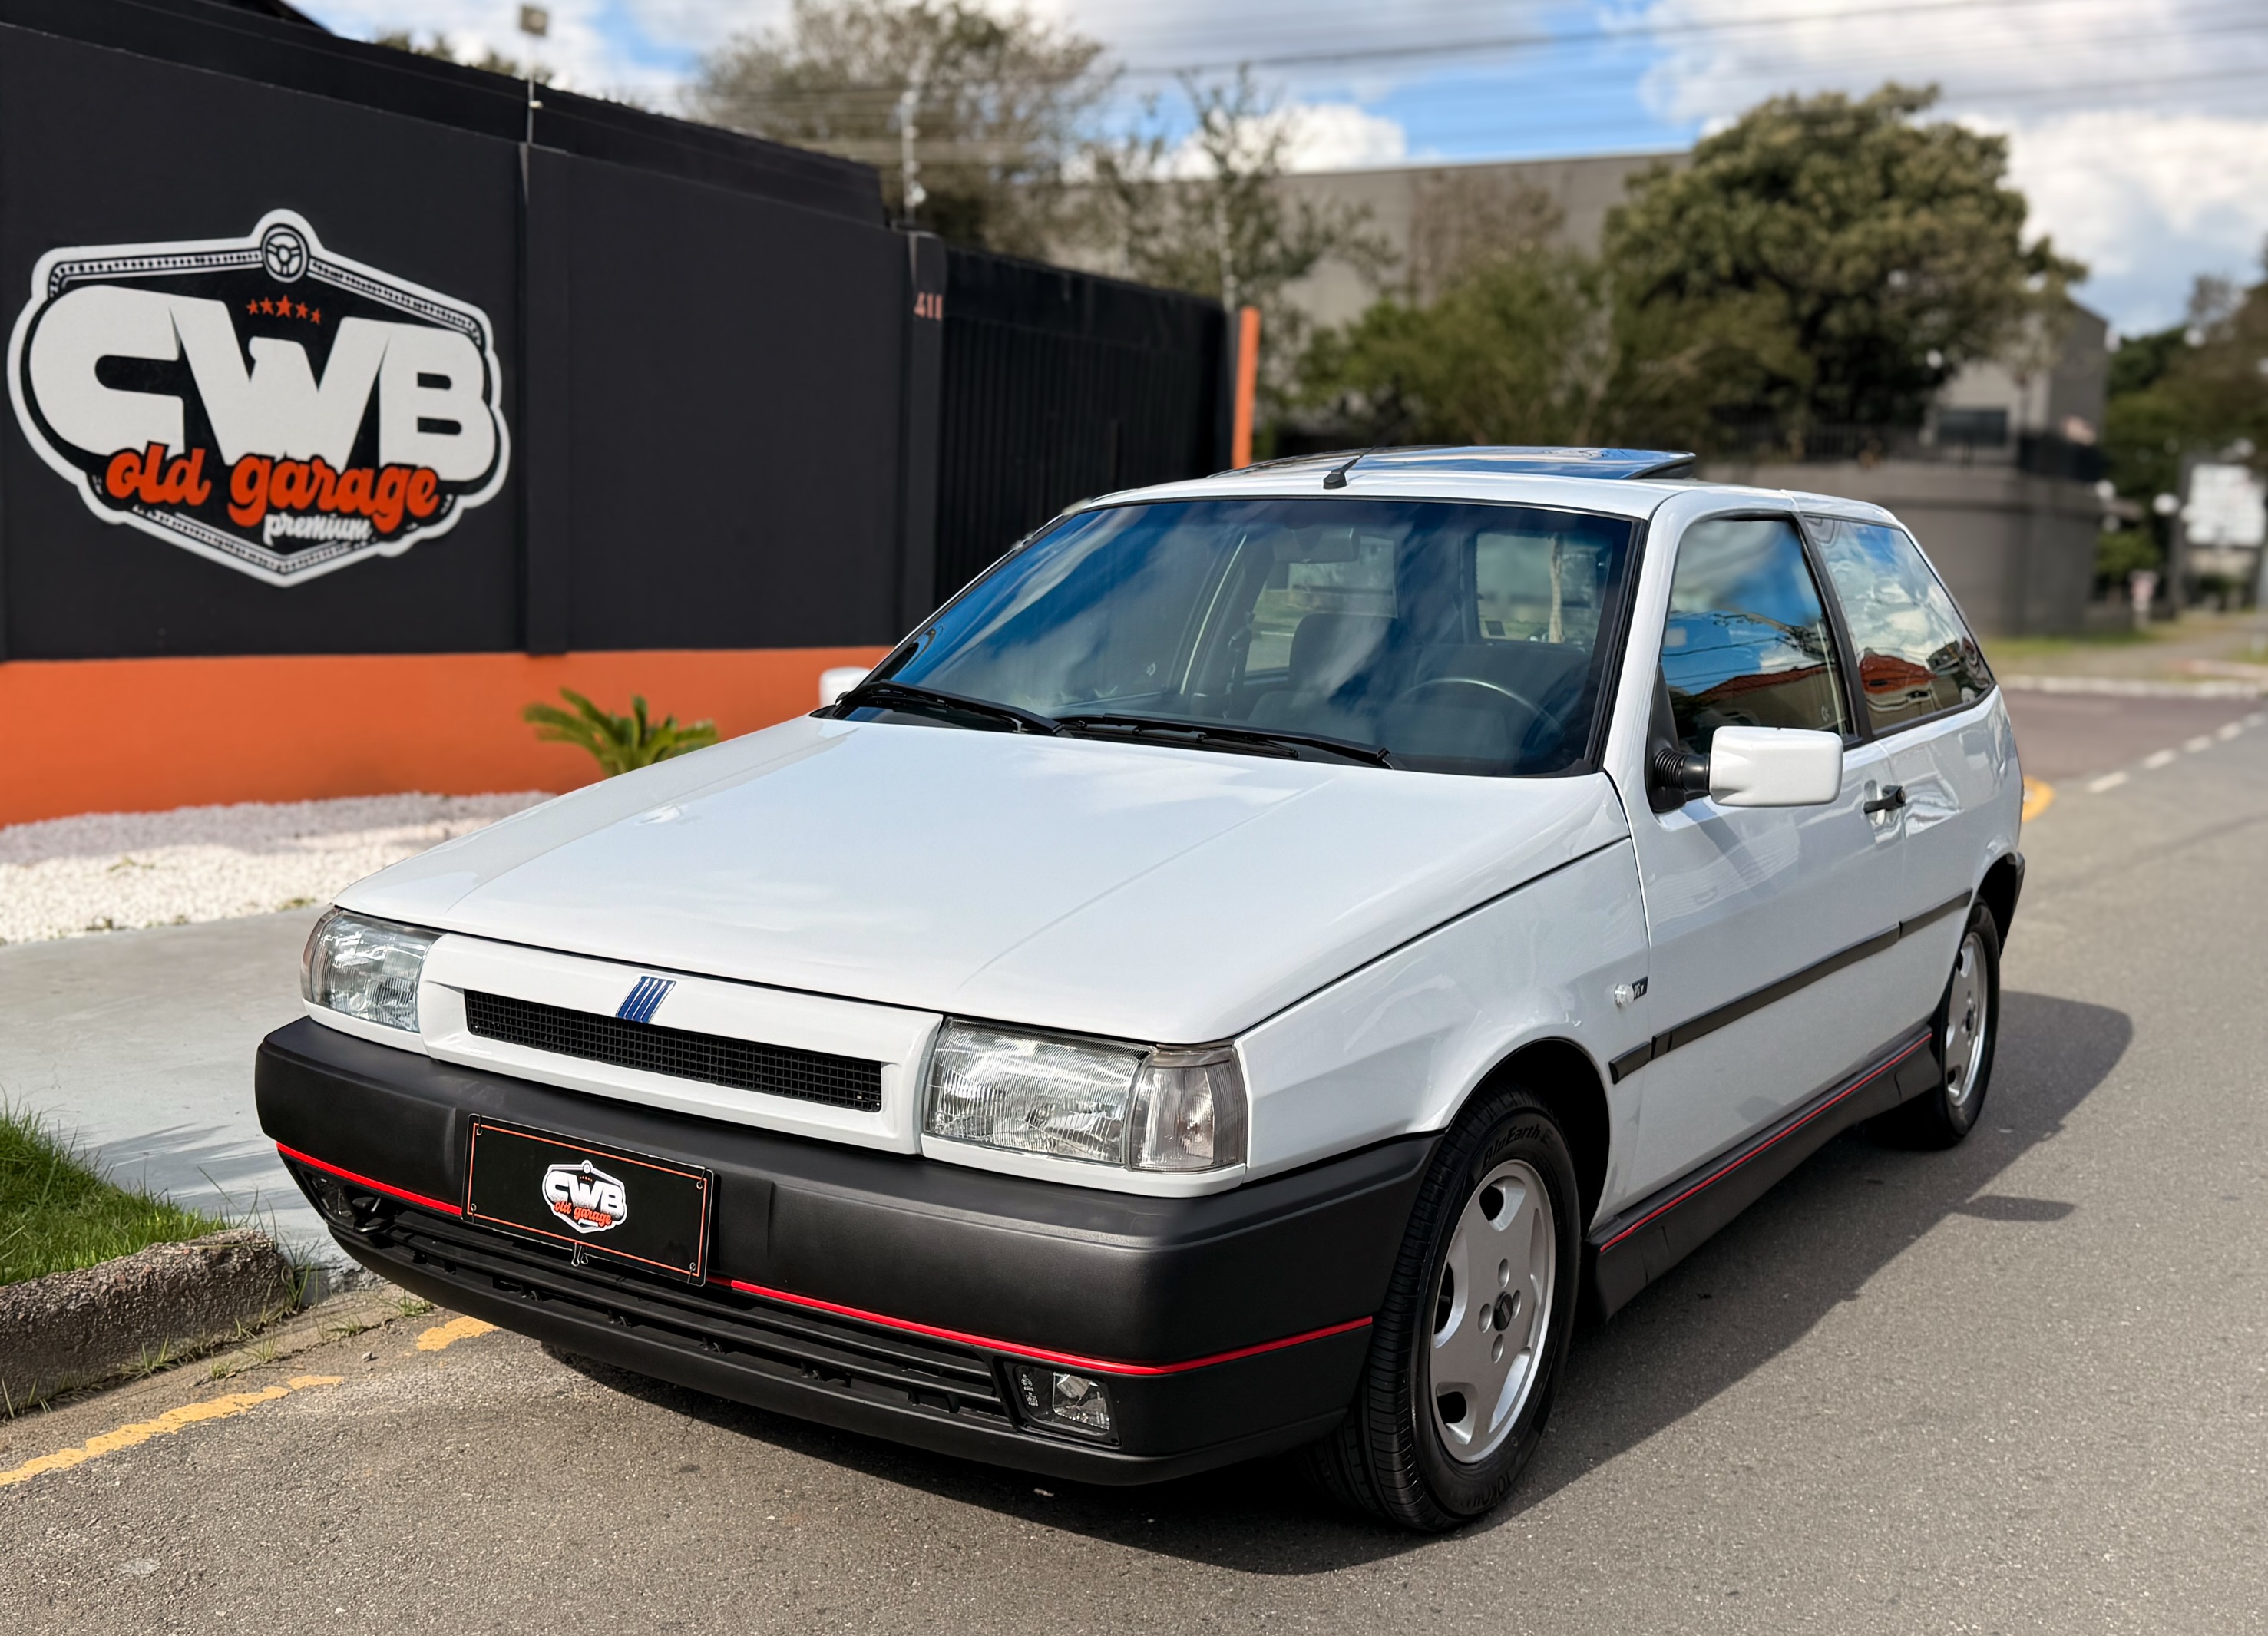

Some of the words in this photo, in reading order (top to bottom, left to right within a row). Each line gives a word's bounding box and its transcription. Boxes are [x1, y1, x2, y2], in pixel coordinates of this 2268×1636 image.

[914, 292, 943, 320] 411
[29, 285, 496, 481] CWB
[105, 443, 211, 505] old
[227, 454, 440, 533] garage
[263, 511, 373, 547] premium
[545, 1170, 625, 1219] CWB
[554, 1201, 572, 1215] old
[574, 1207, 612, 1228] garage
